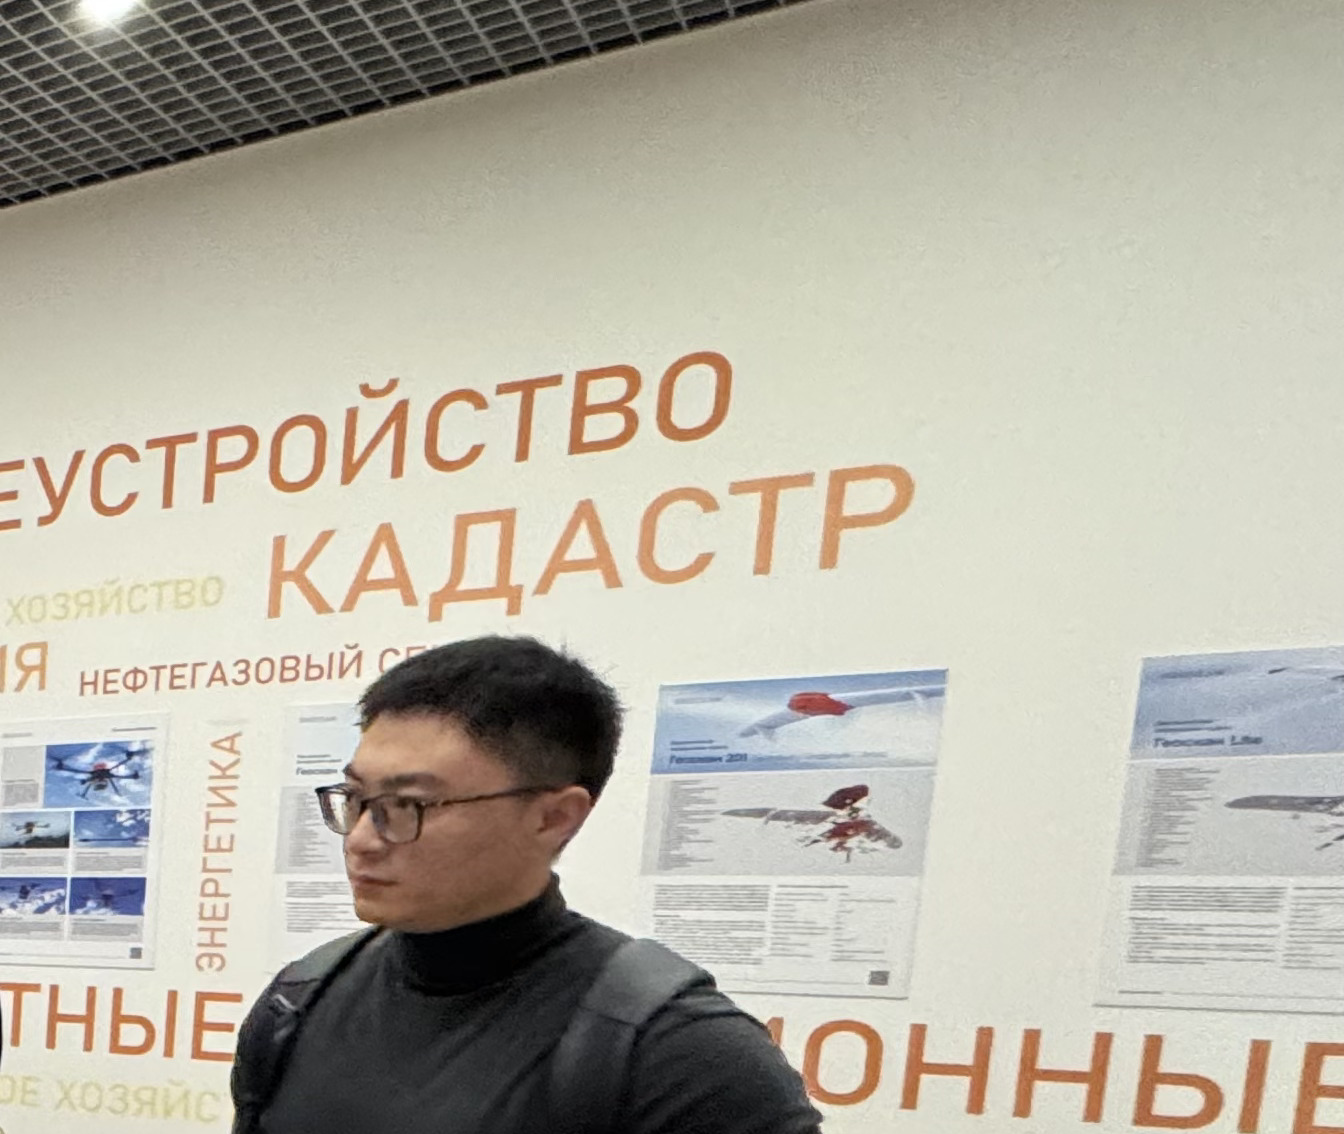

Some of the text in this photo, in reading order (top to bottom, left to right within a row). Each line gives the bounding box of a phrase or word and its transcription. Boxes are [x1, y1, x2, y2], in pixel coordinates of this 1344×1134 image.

[266, 464, 916, 623] КАДАСТР
[5, 576, 224, 628] ХОЗЯЙСТВО
[79, 643, 363, 697] НЕФТЕГАЗОВЫЙ
[195, 731, 243, 972] ЭНЕРГЕТИКА
[54, 1079, 226, 1123] ХОЗЯЙС
